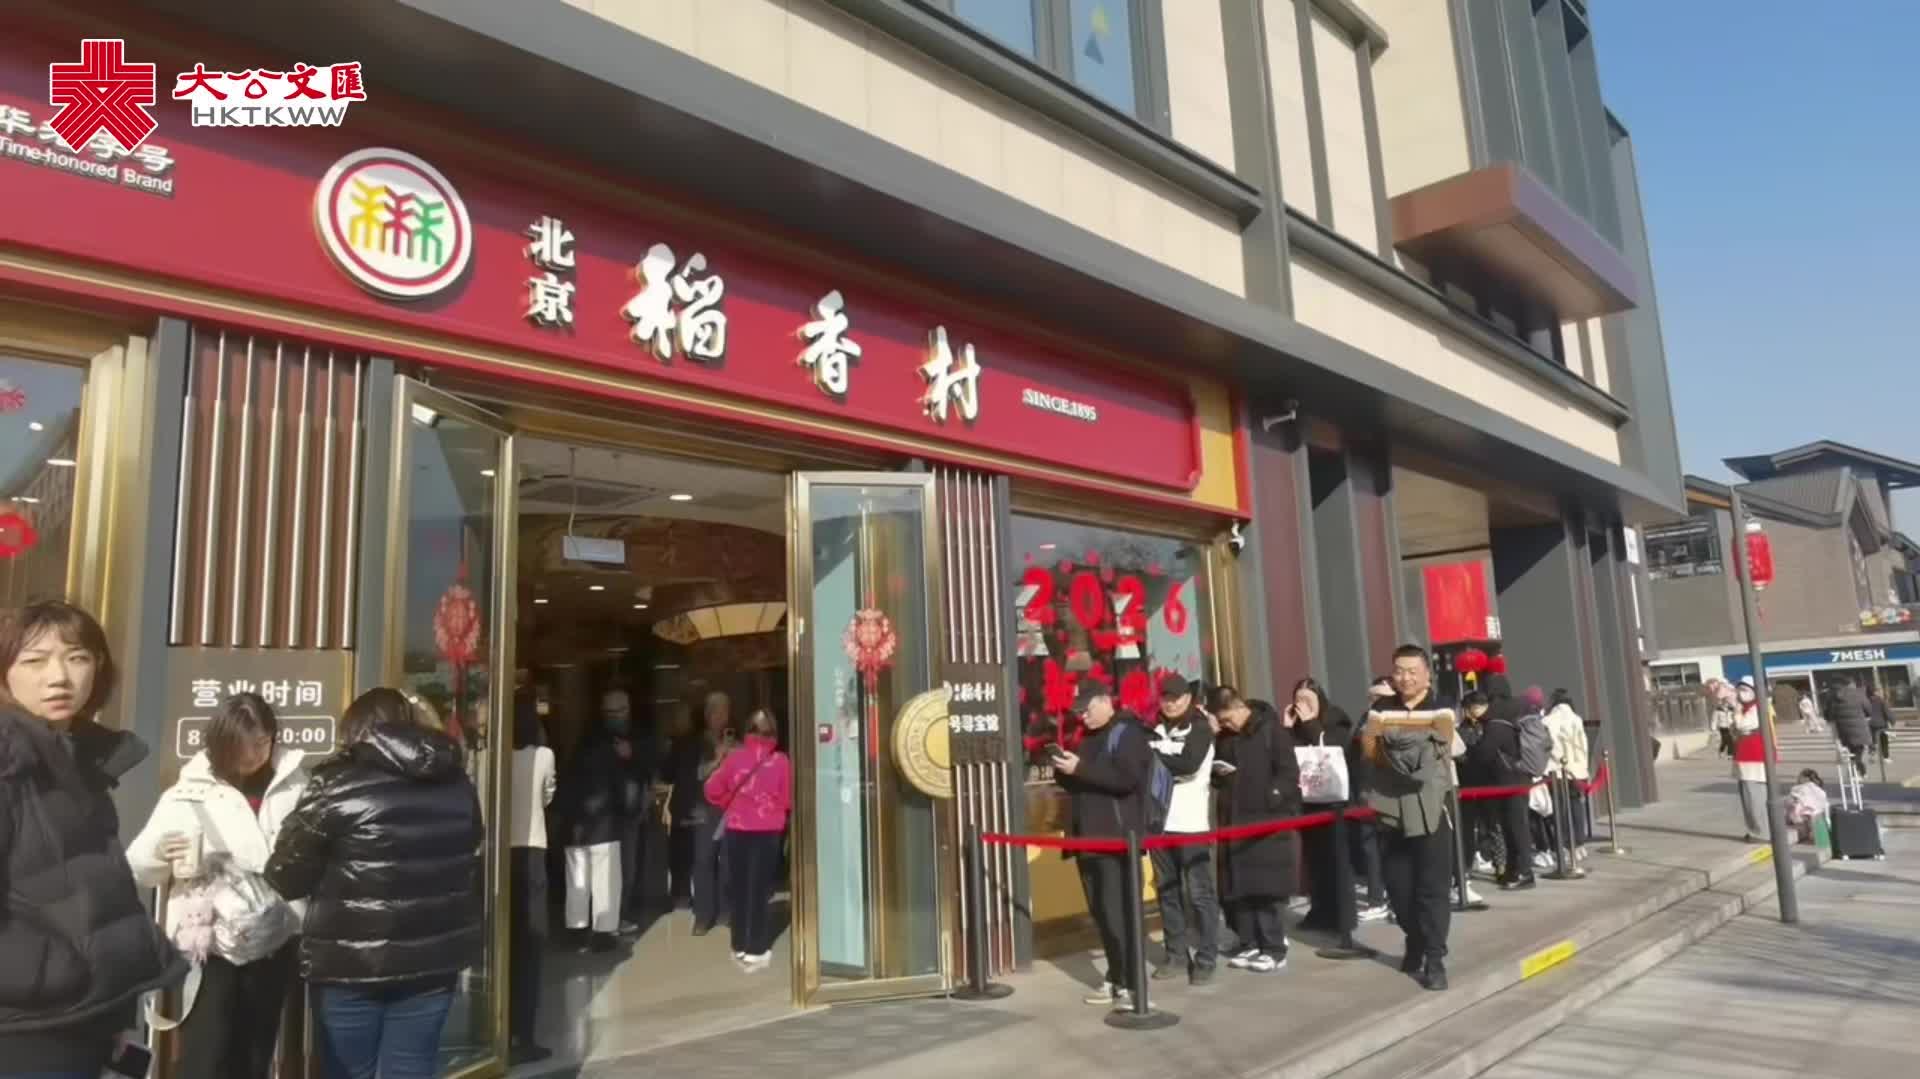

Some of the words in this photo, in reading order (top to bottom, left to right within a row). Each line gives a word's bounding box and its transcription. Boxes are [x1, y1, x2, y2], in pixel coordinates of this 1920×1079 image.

[0, 136, 118, 179] Time-honored
[123, 167, 173, 192] Brand
[527, 215, 576, 325] 北京
[621, 242, 981, 421] 稻香村
[1024, 567, 1189, 636] 2026
[1830, 648, 1886, 662] 7MESH
[191, 679, 323, 707] 营业时间
